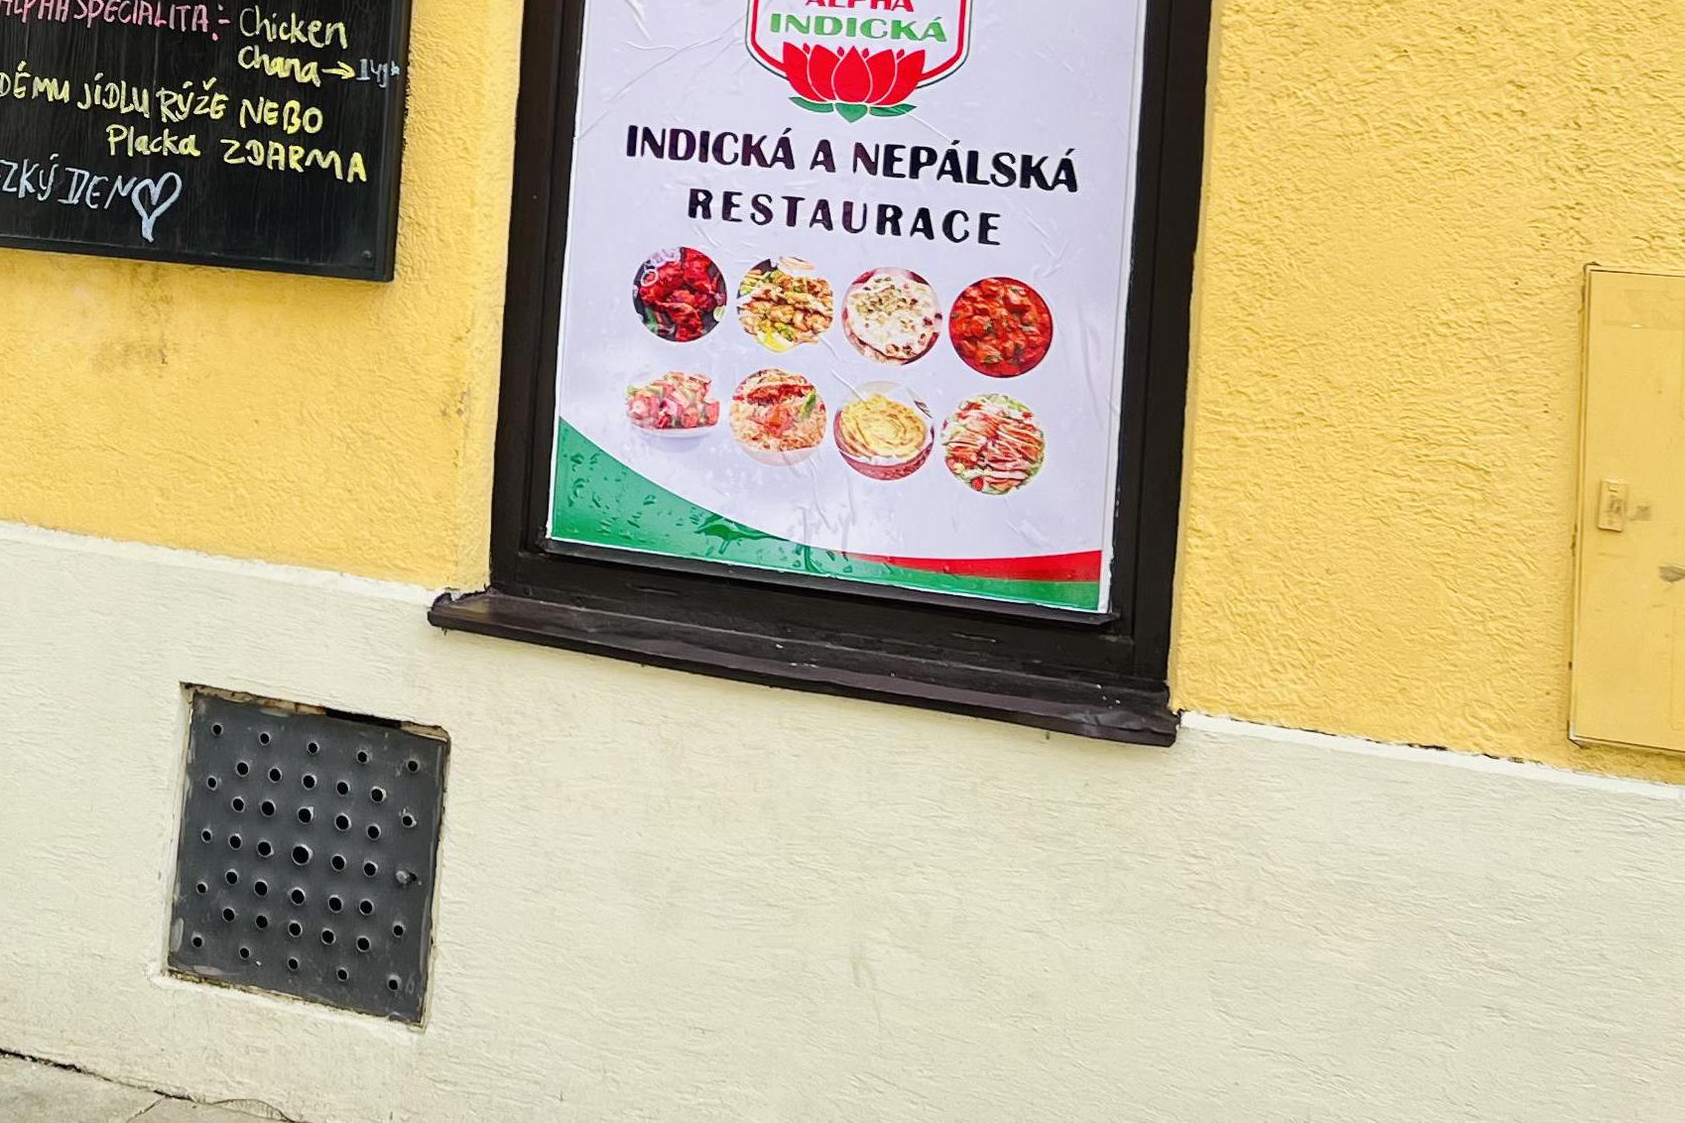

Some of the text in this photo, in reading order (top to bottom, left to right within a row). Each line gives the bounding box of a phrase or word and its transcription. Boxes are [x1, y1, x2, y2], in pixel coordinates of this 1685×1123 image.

[239, 5, 348, 49] Chicken
[769, 12, 948, 44] INDICKÁ
[237, 45, 321, 87] Chana
[76, 72, 151, 119] JÍDLU
[156, 77, 229, 123] RÝŽE
[239, 96, 323, 135] NEBO
[106, 123, 367, 183] Placka ZDARMA
[626, 124, 1079, 194] INDICKÁ A NEPÁLSKÁ
[57, 167, 137, 210] DEN
[687, 187, 1002, 247] RESTAURACE
